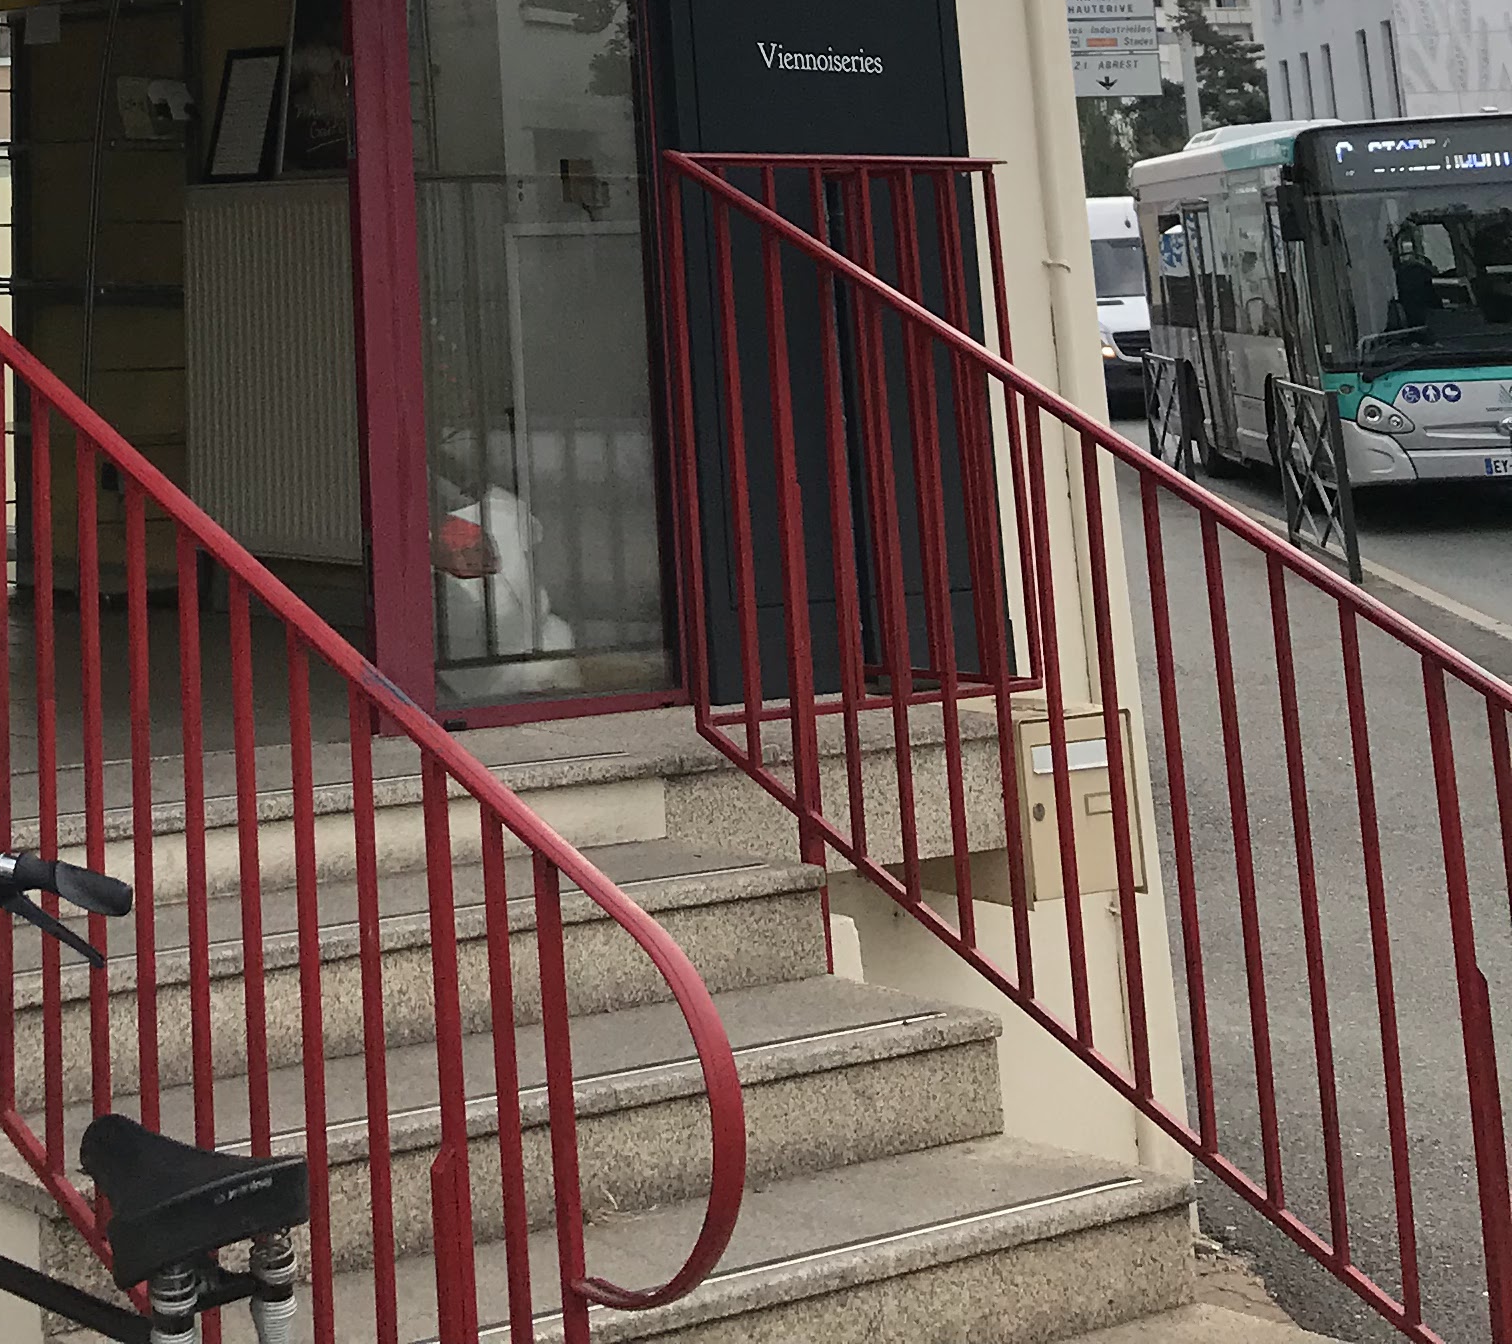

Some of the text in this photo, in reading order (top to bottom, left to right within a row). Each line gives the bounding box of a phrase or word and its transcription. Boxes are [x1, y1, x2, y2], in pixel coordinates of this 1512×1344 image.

[1068, 4, 1134, 14] HAUTERIVE
[757, 41, 884, 74] Viennoiseries
[1098, 60, 1138, 70] ABREST
